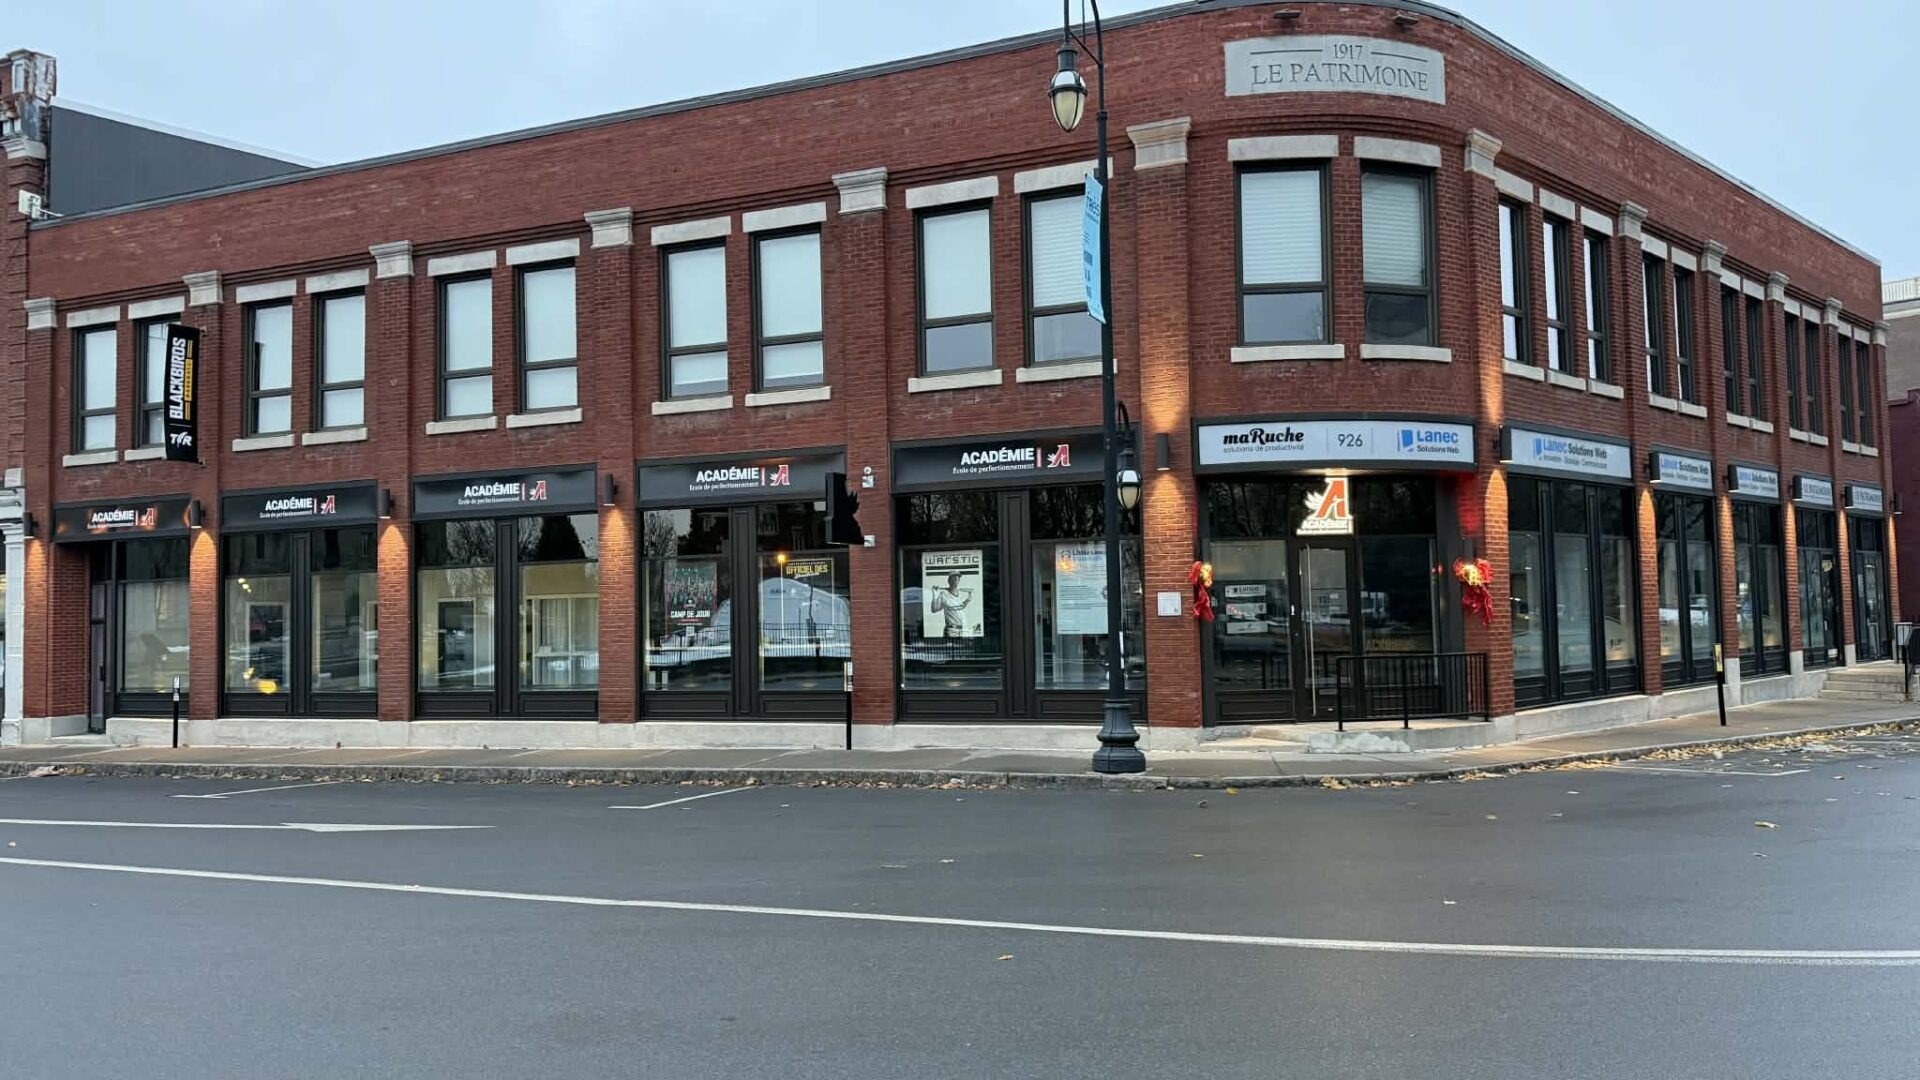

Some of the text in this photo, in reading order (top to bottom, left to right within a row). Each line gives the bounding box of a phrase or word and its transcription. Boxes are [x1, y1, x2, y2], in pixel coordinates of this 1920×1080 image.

[1332, 43, 1364, 60] 1917
[1251, 63, 1429, 91] LE PATRIMOINE
[169, 337, 186, 420] BLACKBIRDS
[1223, 426, 1305, 445] maRuche
[1337, 433, 1364, 447] 926
[1416, 429, 1459, 443] Lanec
[1255, 444, 1264, 452] de
[1416, 445, 1446, 453] Solutions
[1568, 442, 1594, 457] Solutions
[960, 446, 1035, 466] ACADÉMIE
[695, 466, 759, 483] ACADÉMIE
[464, 482, 520, 498] ACADÉMIE
[265, 497, 312, 510] ACADÉMIE
[92, 509, 134, 522] ACADÉMIE
[670, 610, 686, 619] CAMP
[686, 610, 695, 618] DE
